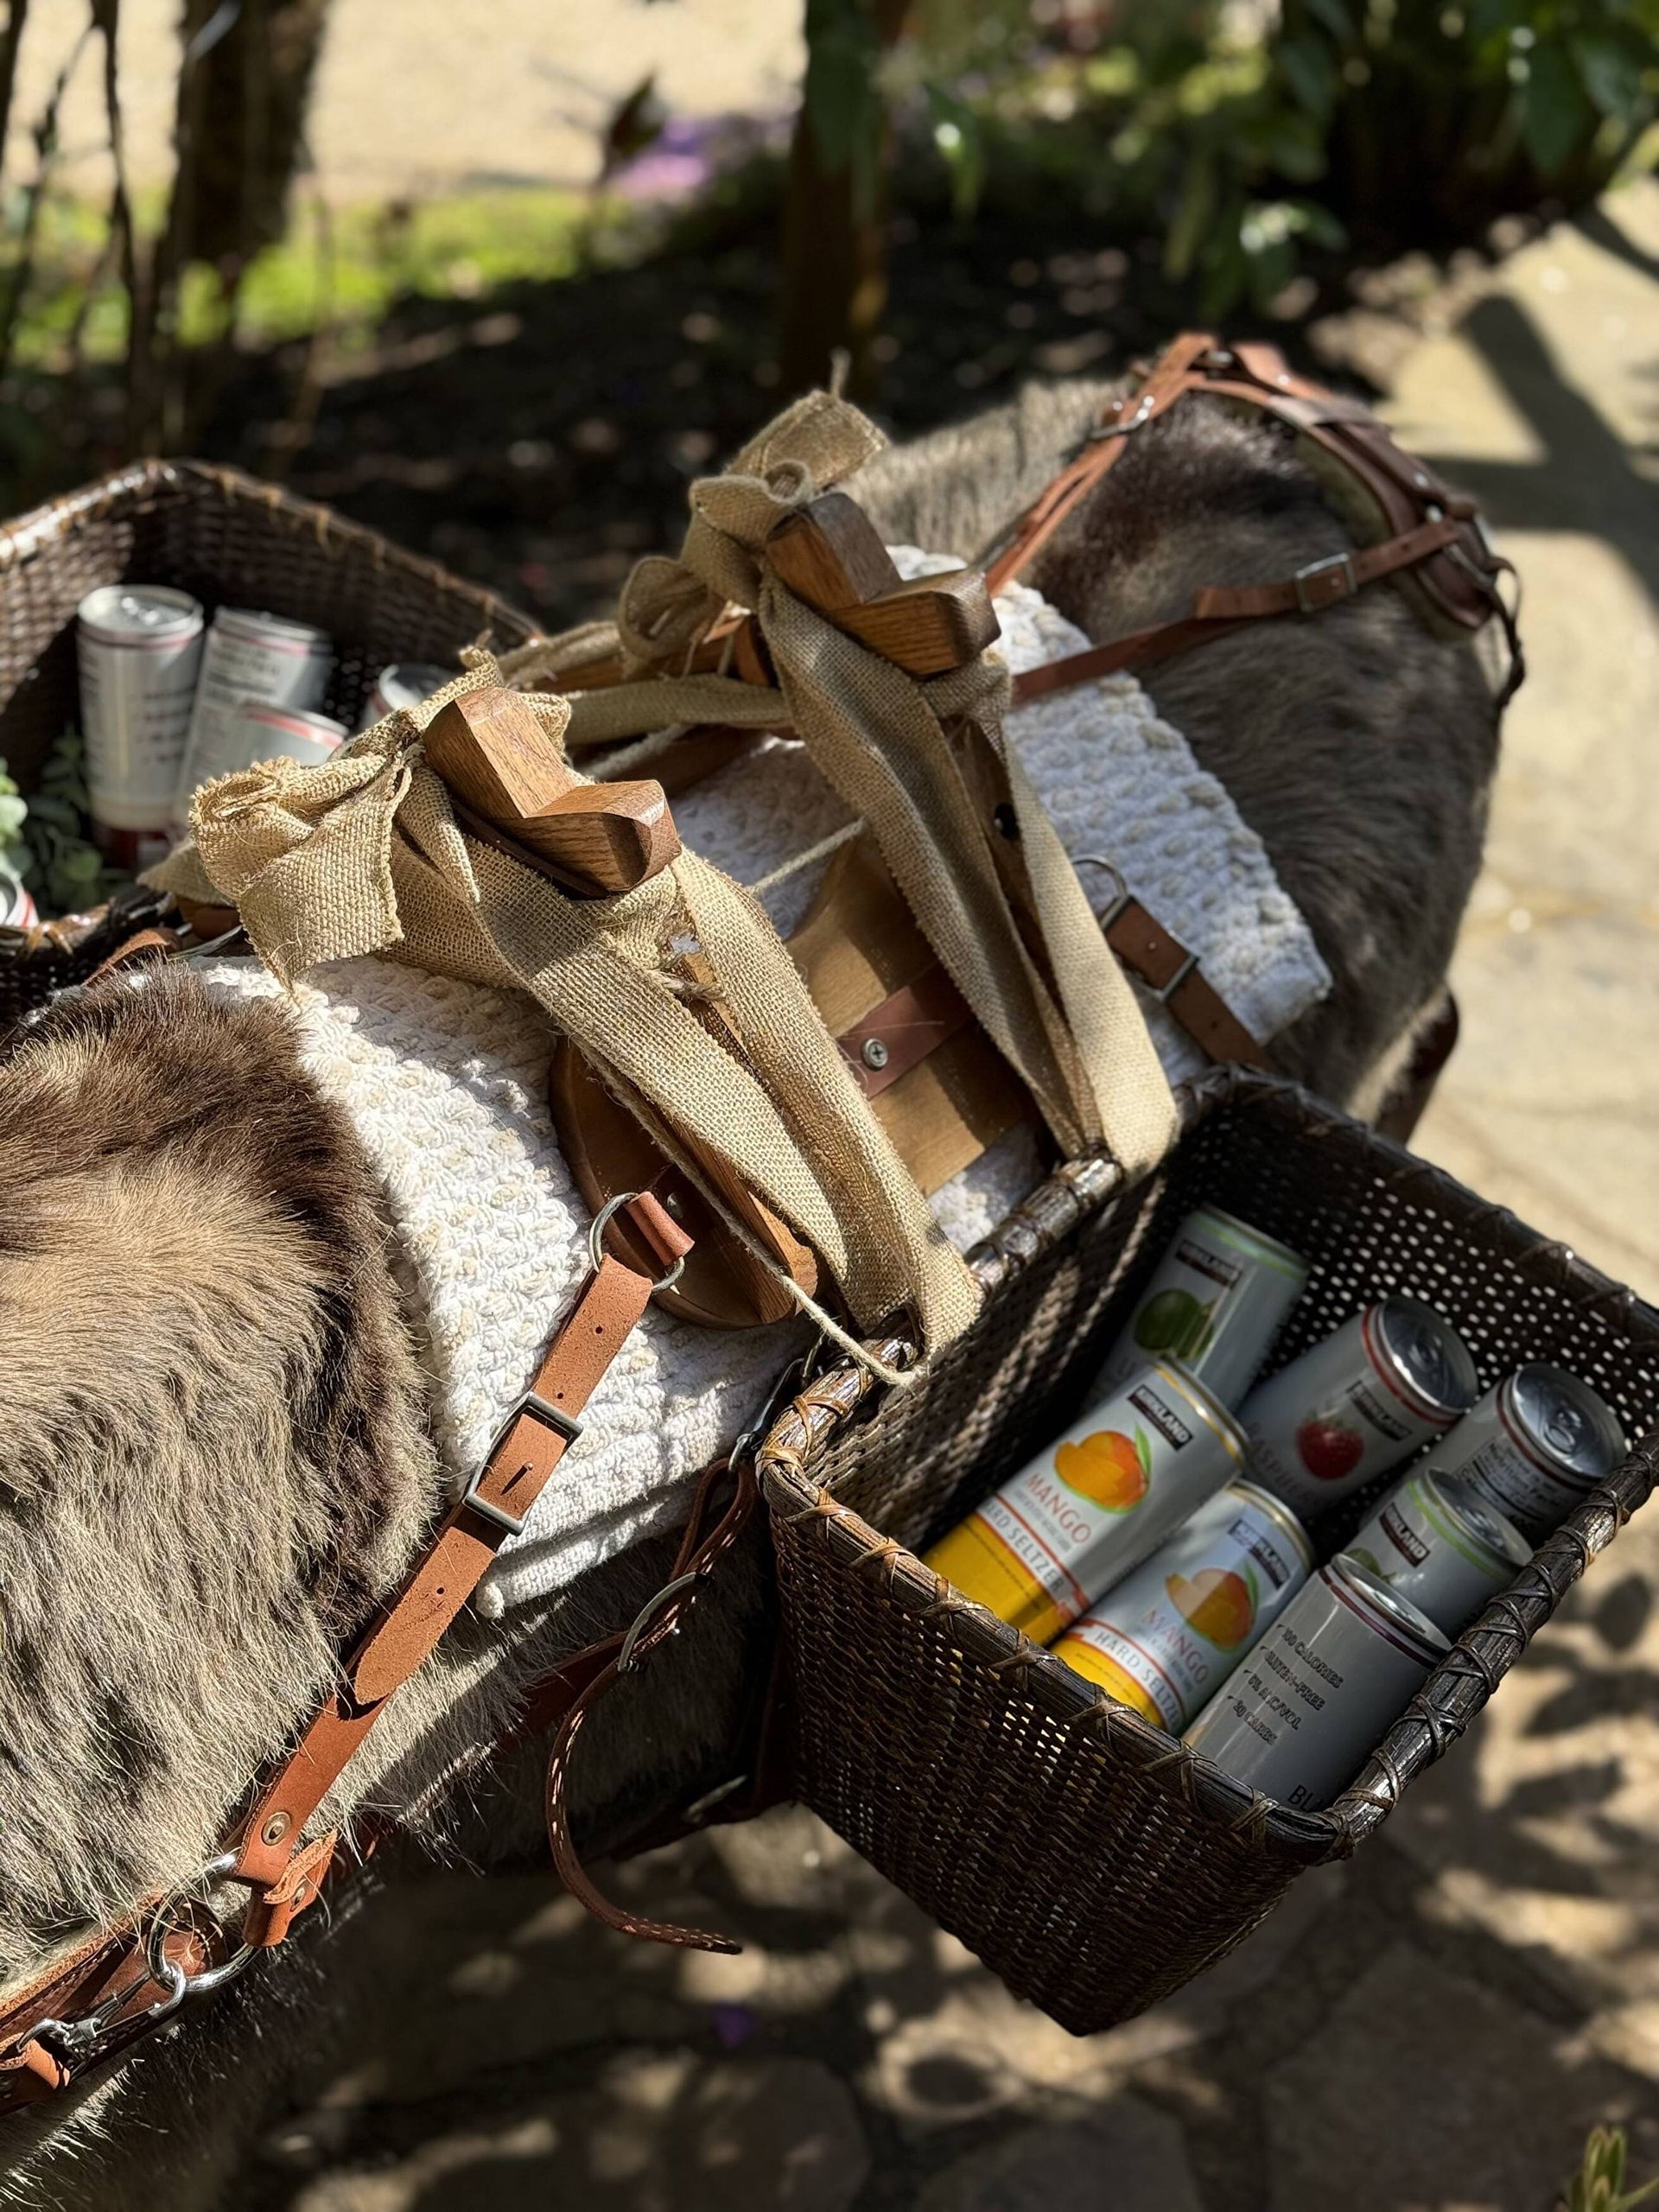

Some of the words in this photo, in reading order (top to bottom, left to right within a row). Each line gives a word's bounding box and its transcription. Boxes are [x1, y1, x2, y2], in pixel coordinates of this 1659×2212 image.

[1134, 1386, 1191, 1444] KIRKLAND
[1027, 1473, 1091, 1543] MANGO
[1384, 1504, 1427, 1560] KIRKLAND
[1008, 1527, 1065, 1592] SELTZER
[1094, 1631, 1141, 1669] HARD
[1141, 1610, 1210, 1685] MANGO
[1294, 1643, 1344, 1689] CALORIES
[1244, 1712, 1279, 1745] CARBS
[1259, 1688, 1301, 1731] ALC/VOL
